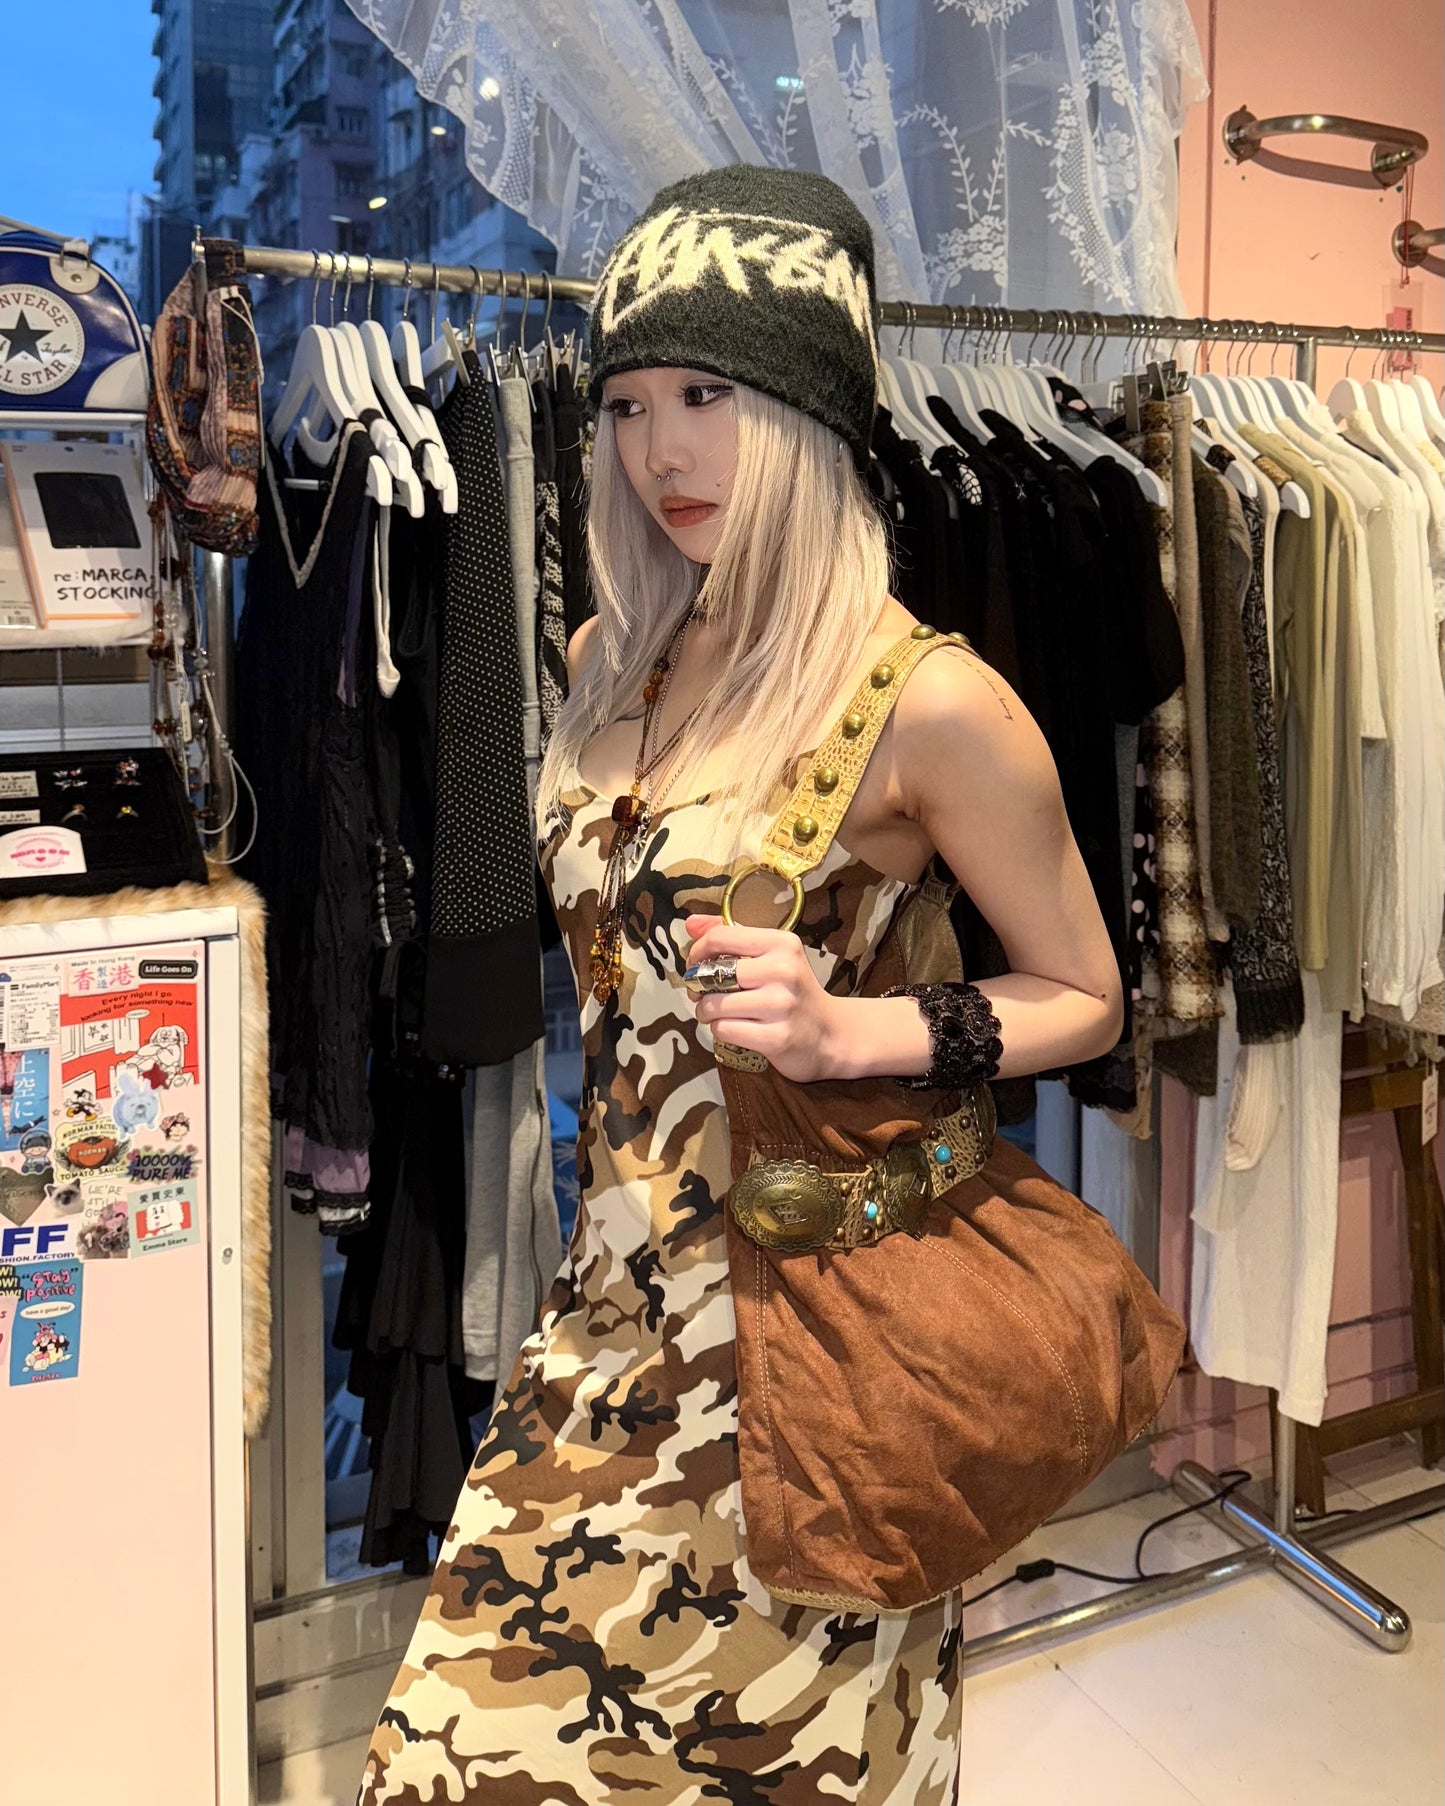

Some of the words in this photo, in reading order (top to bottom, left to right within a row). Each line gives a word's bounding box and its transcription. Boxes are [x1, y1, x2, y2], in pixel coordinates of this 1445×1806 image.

[21, 359, 66, 386] STAR
[72, 963, 136, 991] 香港
[145, 965, 160, 973] Life
[161, 965, 180, 973] Goes
[181, 965, 193, 974] On
[101, 994, 128, 1006] Every
[130, 991, 152, 999] night
[81, 1007, 112, 1021] looking
[113, 1002, 126, 1010] for
[60, 1169, 95, 1181] TOMATO
[98, 1165, 123, 1175] SAUC
[131, 1167, 169, 1181] PURE
[172, 1167, 190, 1180] ME
[2, 1224, 69, 1256] FF
[142, 1242, 166, 1251] Emma
[167, 1237, 188, 1246] Store
